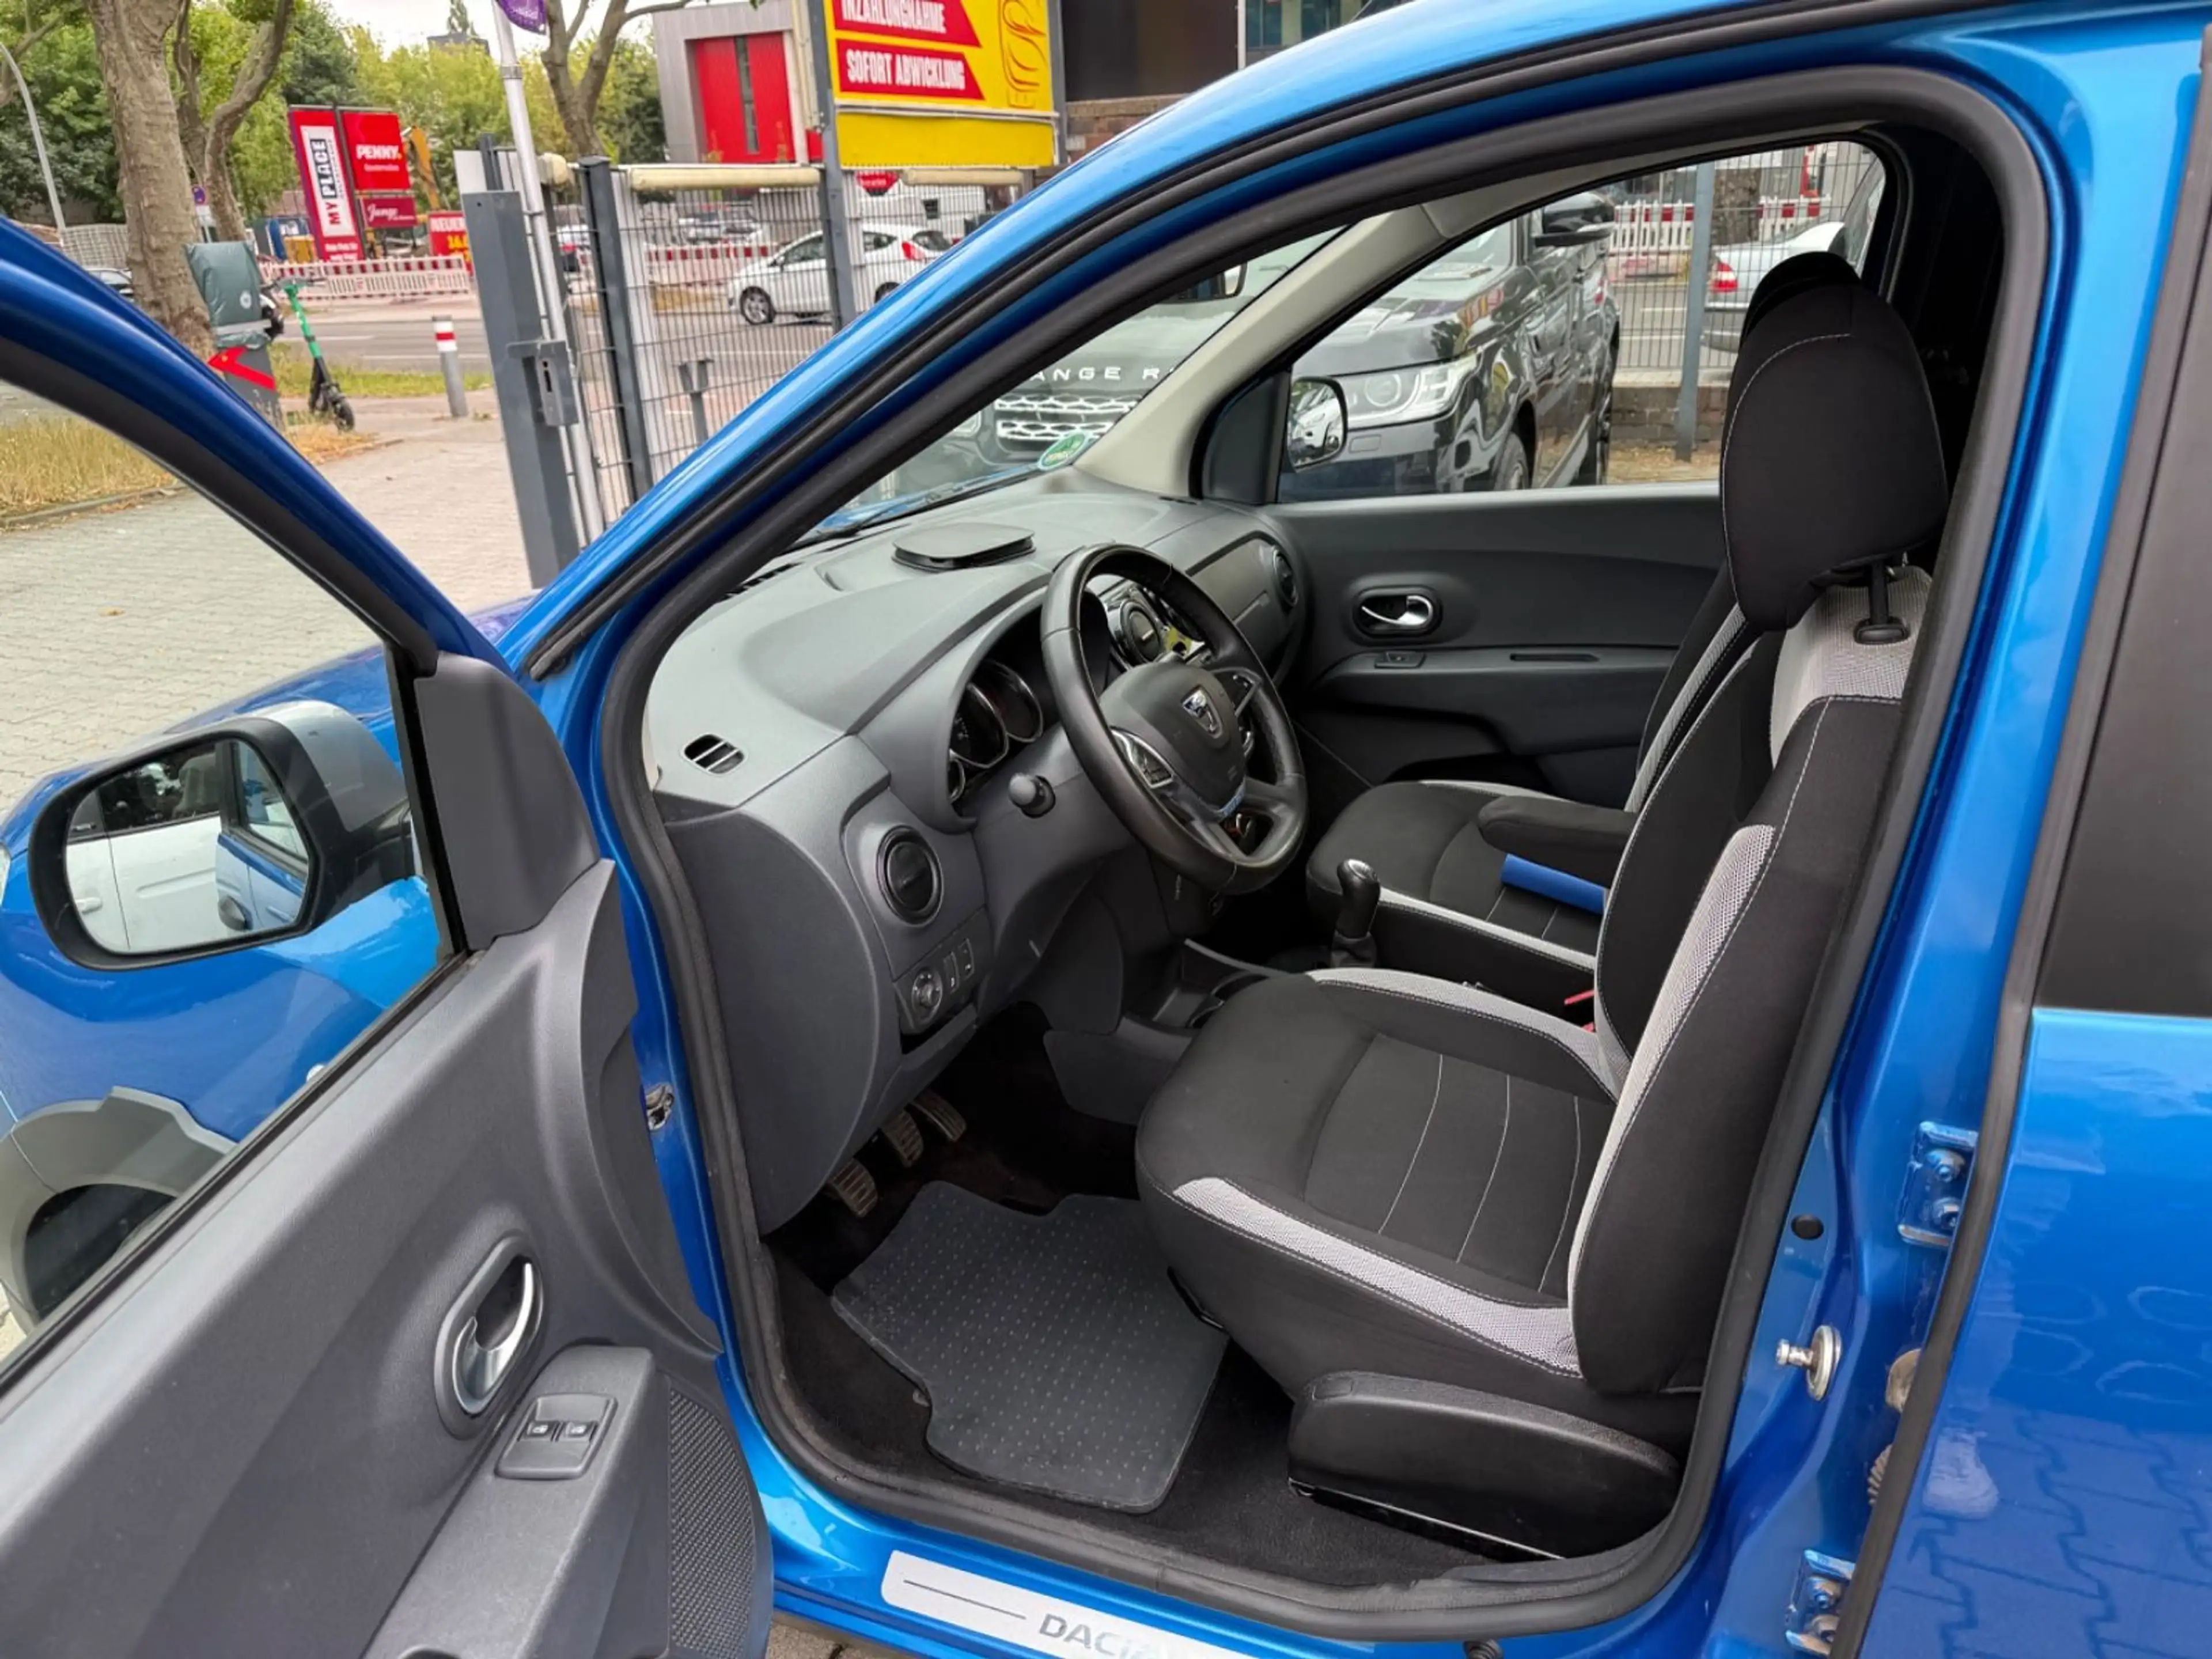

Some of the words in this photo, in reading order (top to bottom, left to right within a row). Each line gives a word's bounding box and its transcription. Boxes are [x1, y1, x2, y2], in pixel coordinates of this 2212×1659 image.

[846, 48, 892, 86] SOFORT
[895, 54, 965, 90] ABWICKLUNG
[310, 139, 336, 198] PLACE
[326, 202, 340, 225] MY
[1029, 366, 1122, 381] ANGE
